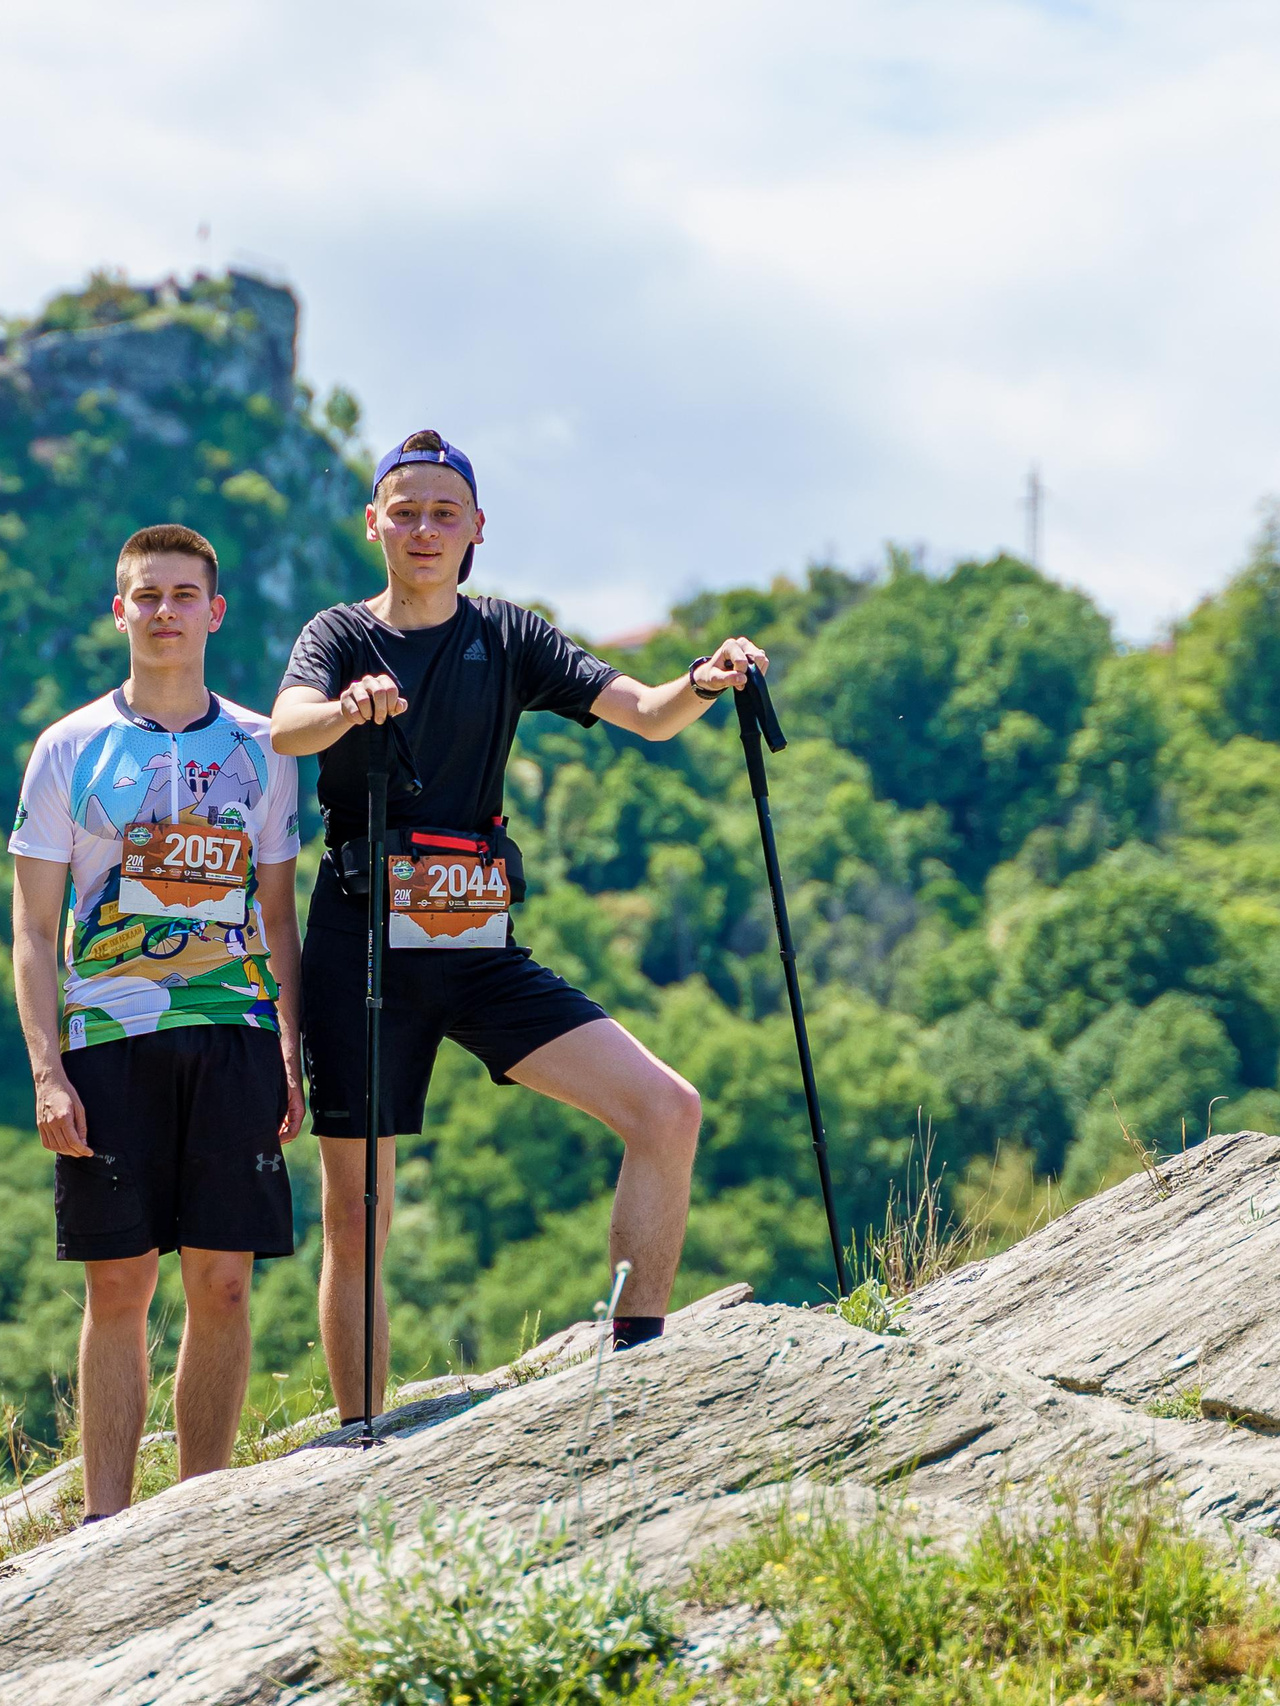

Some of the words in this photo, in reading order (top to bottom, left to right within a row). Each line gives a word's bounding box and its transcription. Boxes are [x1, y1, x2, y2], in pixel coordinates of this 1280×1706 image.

[125, 854, 146, 867] 20K
[163, 833, 241, 872] 2057
[428, 864, 507, 897] 2044
[394, 889, 412, 900] 20K
